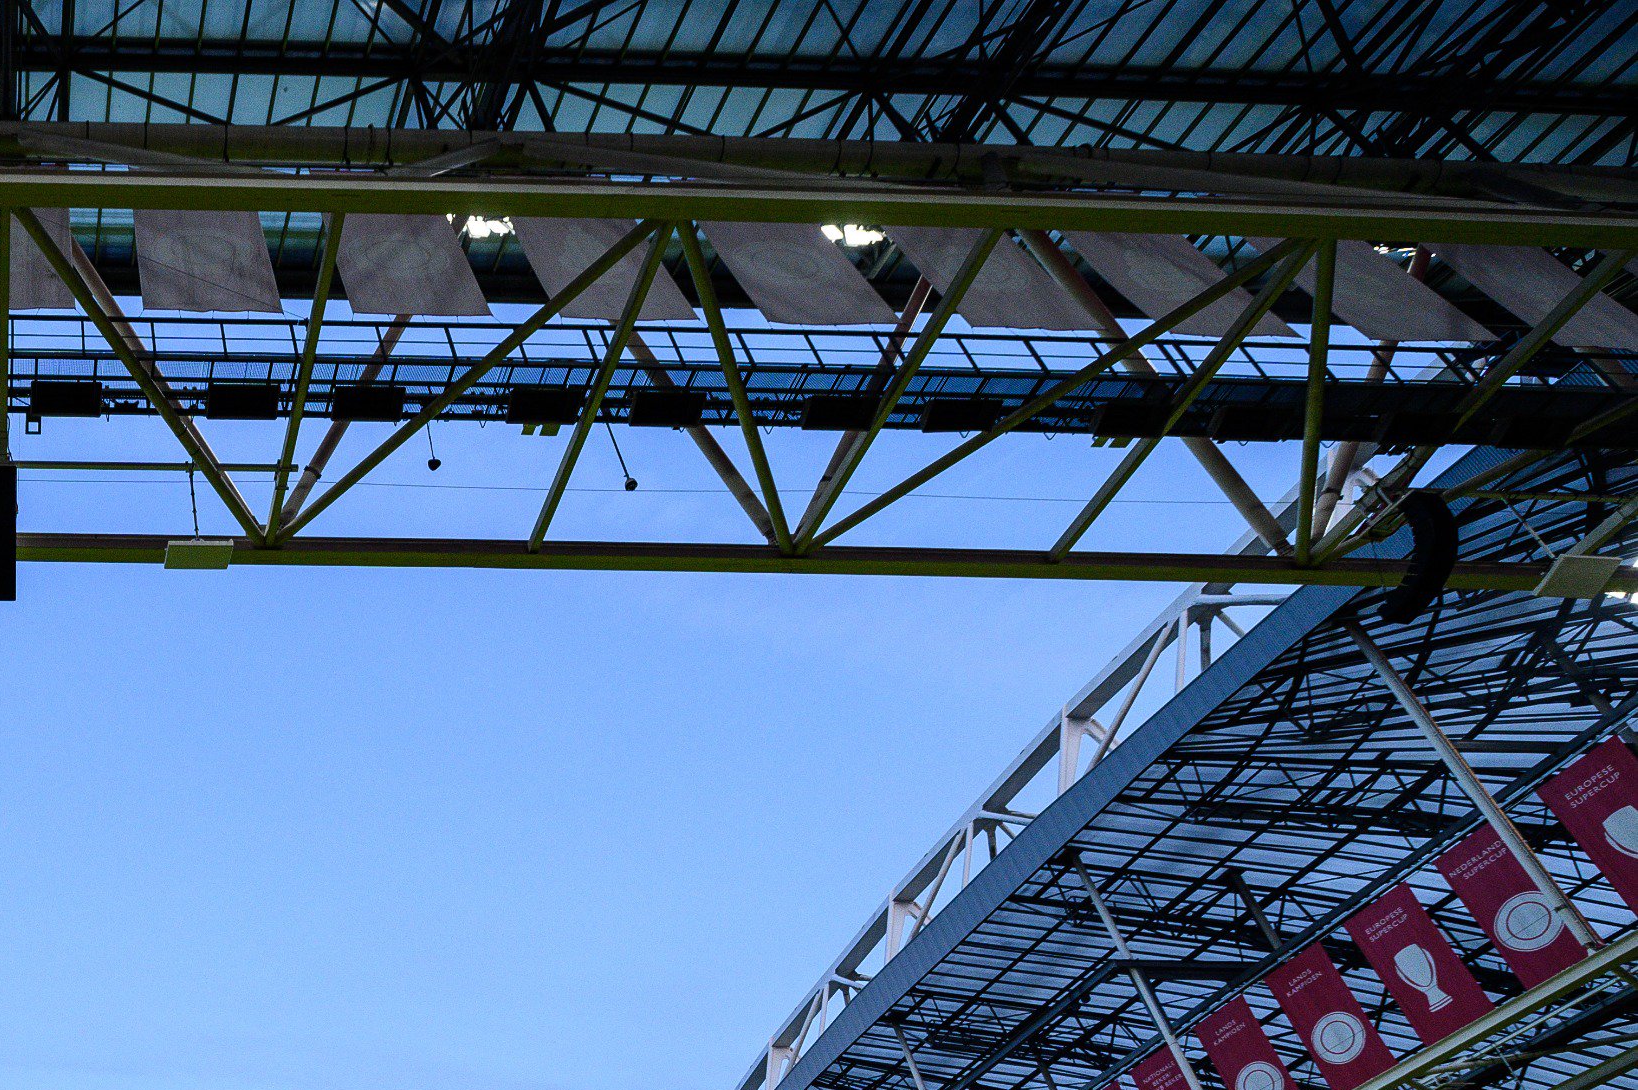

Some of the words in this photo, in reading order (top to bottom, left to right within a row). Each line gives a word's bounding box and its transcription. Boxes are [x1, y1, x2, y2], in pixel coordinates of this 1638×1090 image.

[1564, 764, 1615, 801] EUROPESE
[1570, 771, 1621, 809] SUPERCUP
[1364, 906, 1405, 936] EUROPESE
[1369, 913, 1409, 943] SUPERCUP
[1286, 971, 1323, 998] KAMPIOEN
[1288, 968, 1312, 987] LANDS
[1213, 1022, 1246, 1047] KAMPIOEN
[1215, 1019, 1236, 1036] LANDS
